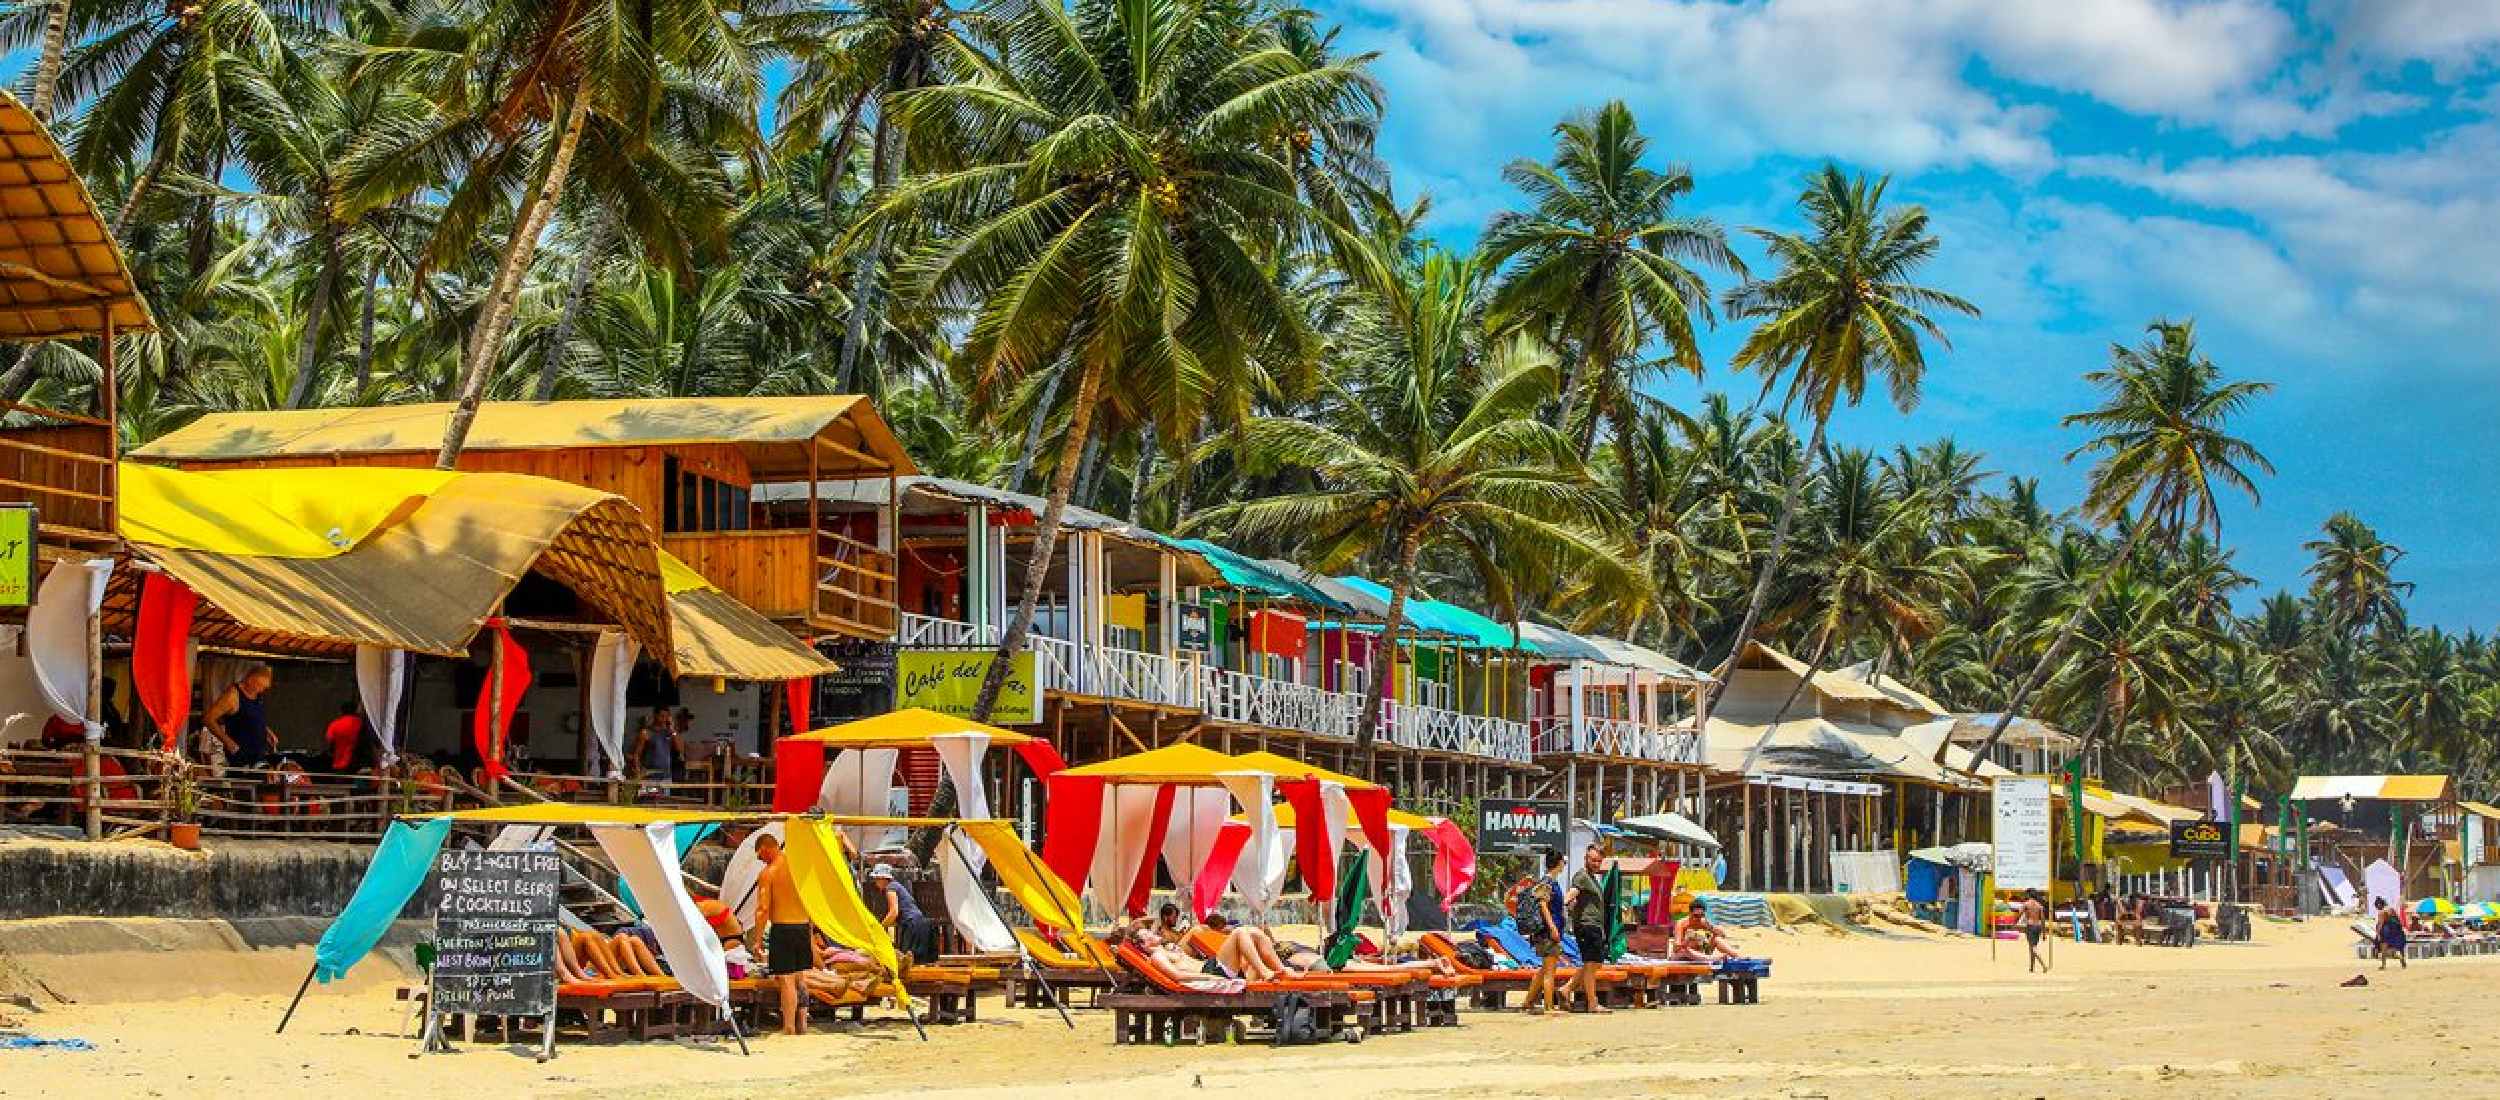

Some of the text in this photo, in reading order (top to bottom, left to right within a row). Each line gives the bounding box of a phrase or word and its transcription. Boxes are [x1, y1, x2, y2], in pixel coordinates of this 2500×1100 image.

[906, 662, 944, 697] Café
[952, 660, 982, 678] del
[1485, 811, 1561, 832] HAVANA
[442, 851, 470, 872] BUY
[496, 854, 519, 870] GET
[522, 853, 531, 872] 1
[534, 855, 559, 872] FREE
[462, 878, 509, 894] SELECT
[457, 896, 532, 915] COCKTAILS
[437, 954, 462, 968] WEST
[503, 953, 543, 968] CHELSEA
